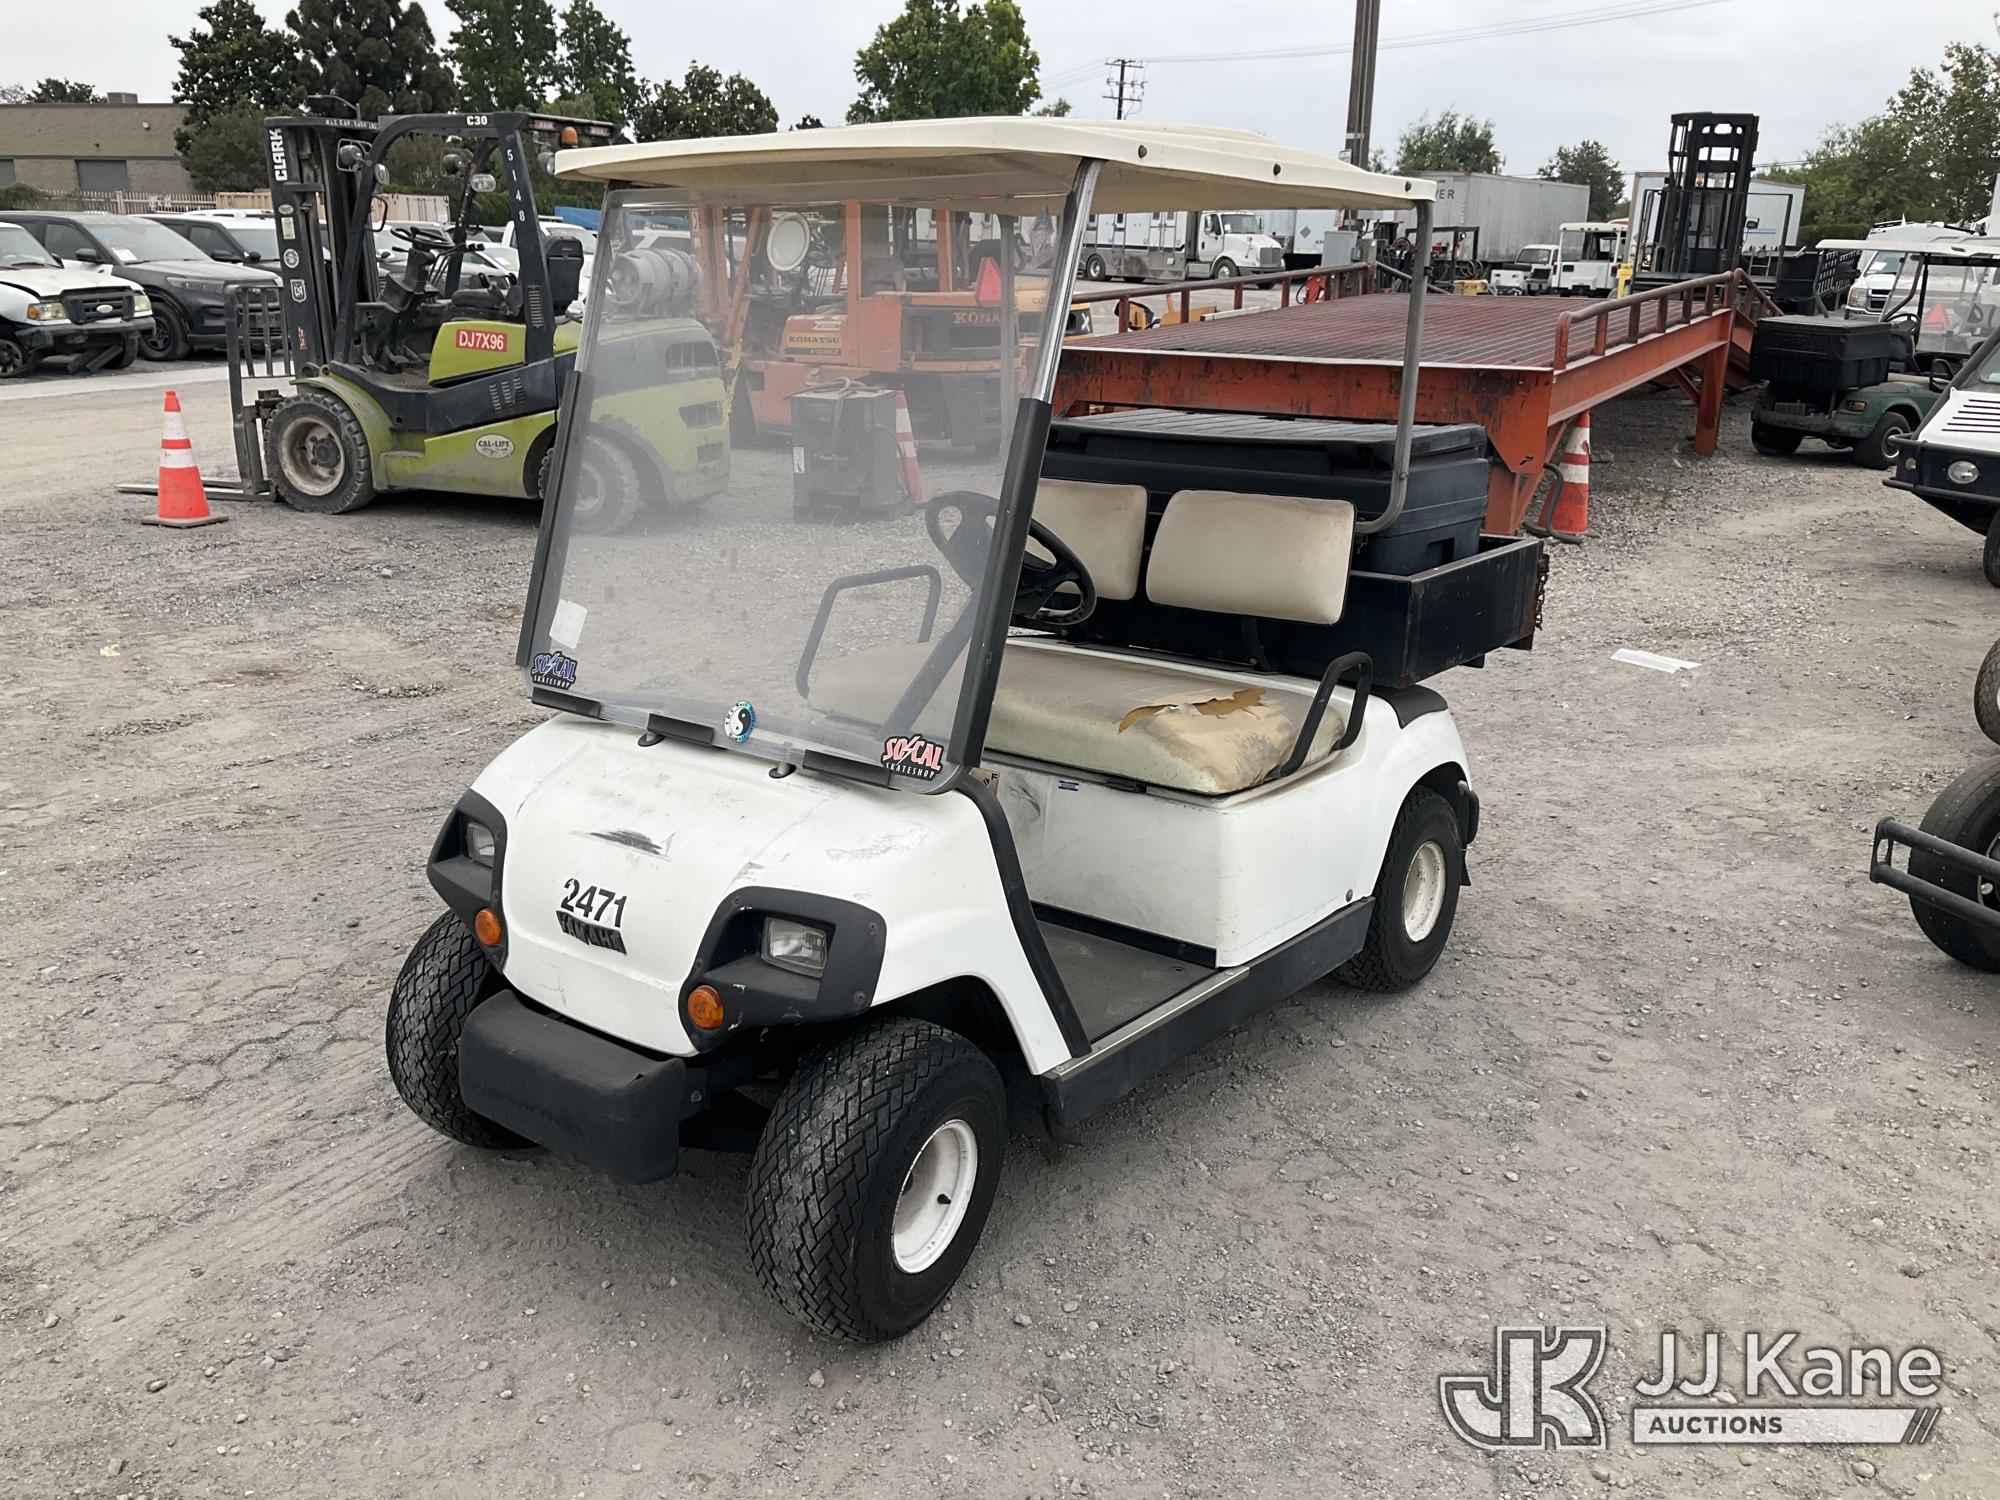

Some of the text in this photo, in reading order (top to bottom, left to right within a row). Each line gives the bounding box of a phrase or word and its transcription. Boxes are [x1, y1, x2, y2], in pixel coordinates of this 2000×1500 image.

[467, 115, 488, 126] C30
[269, 128, 288, 182] CLARK
[953, 311, 1000, 325] KOMA
[458, 330, 505, 350] DJ7X96
[788, 335, 840, 344] KOMATSU
[478, 440, 510, 448] CAL-LIFT
[886, 762, 935, 779] SKATESHOP
[560, 878, 627, 928] 2471
